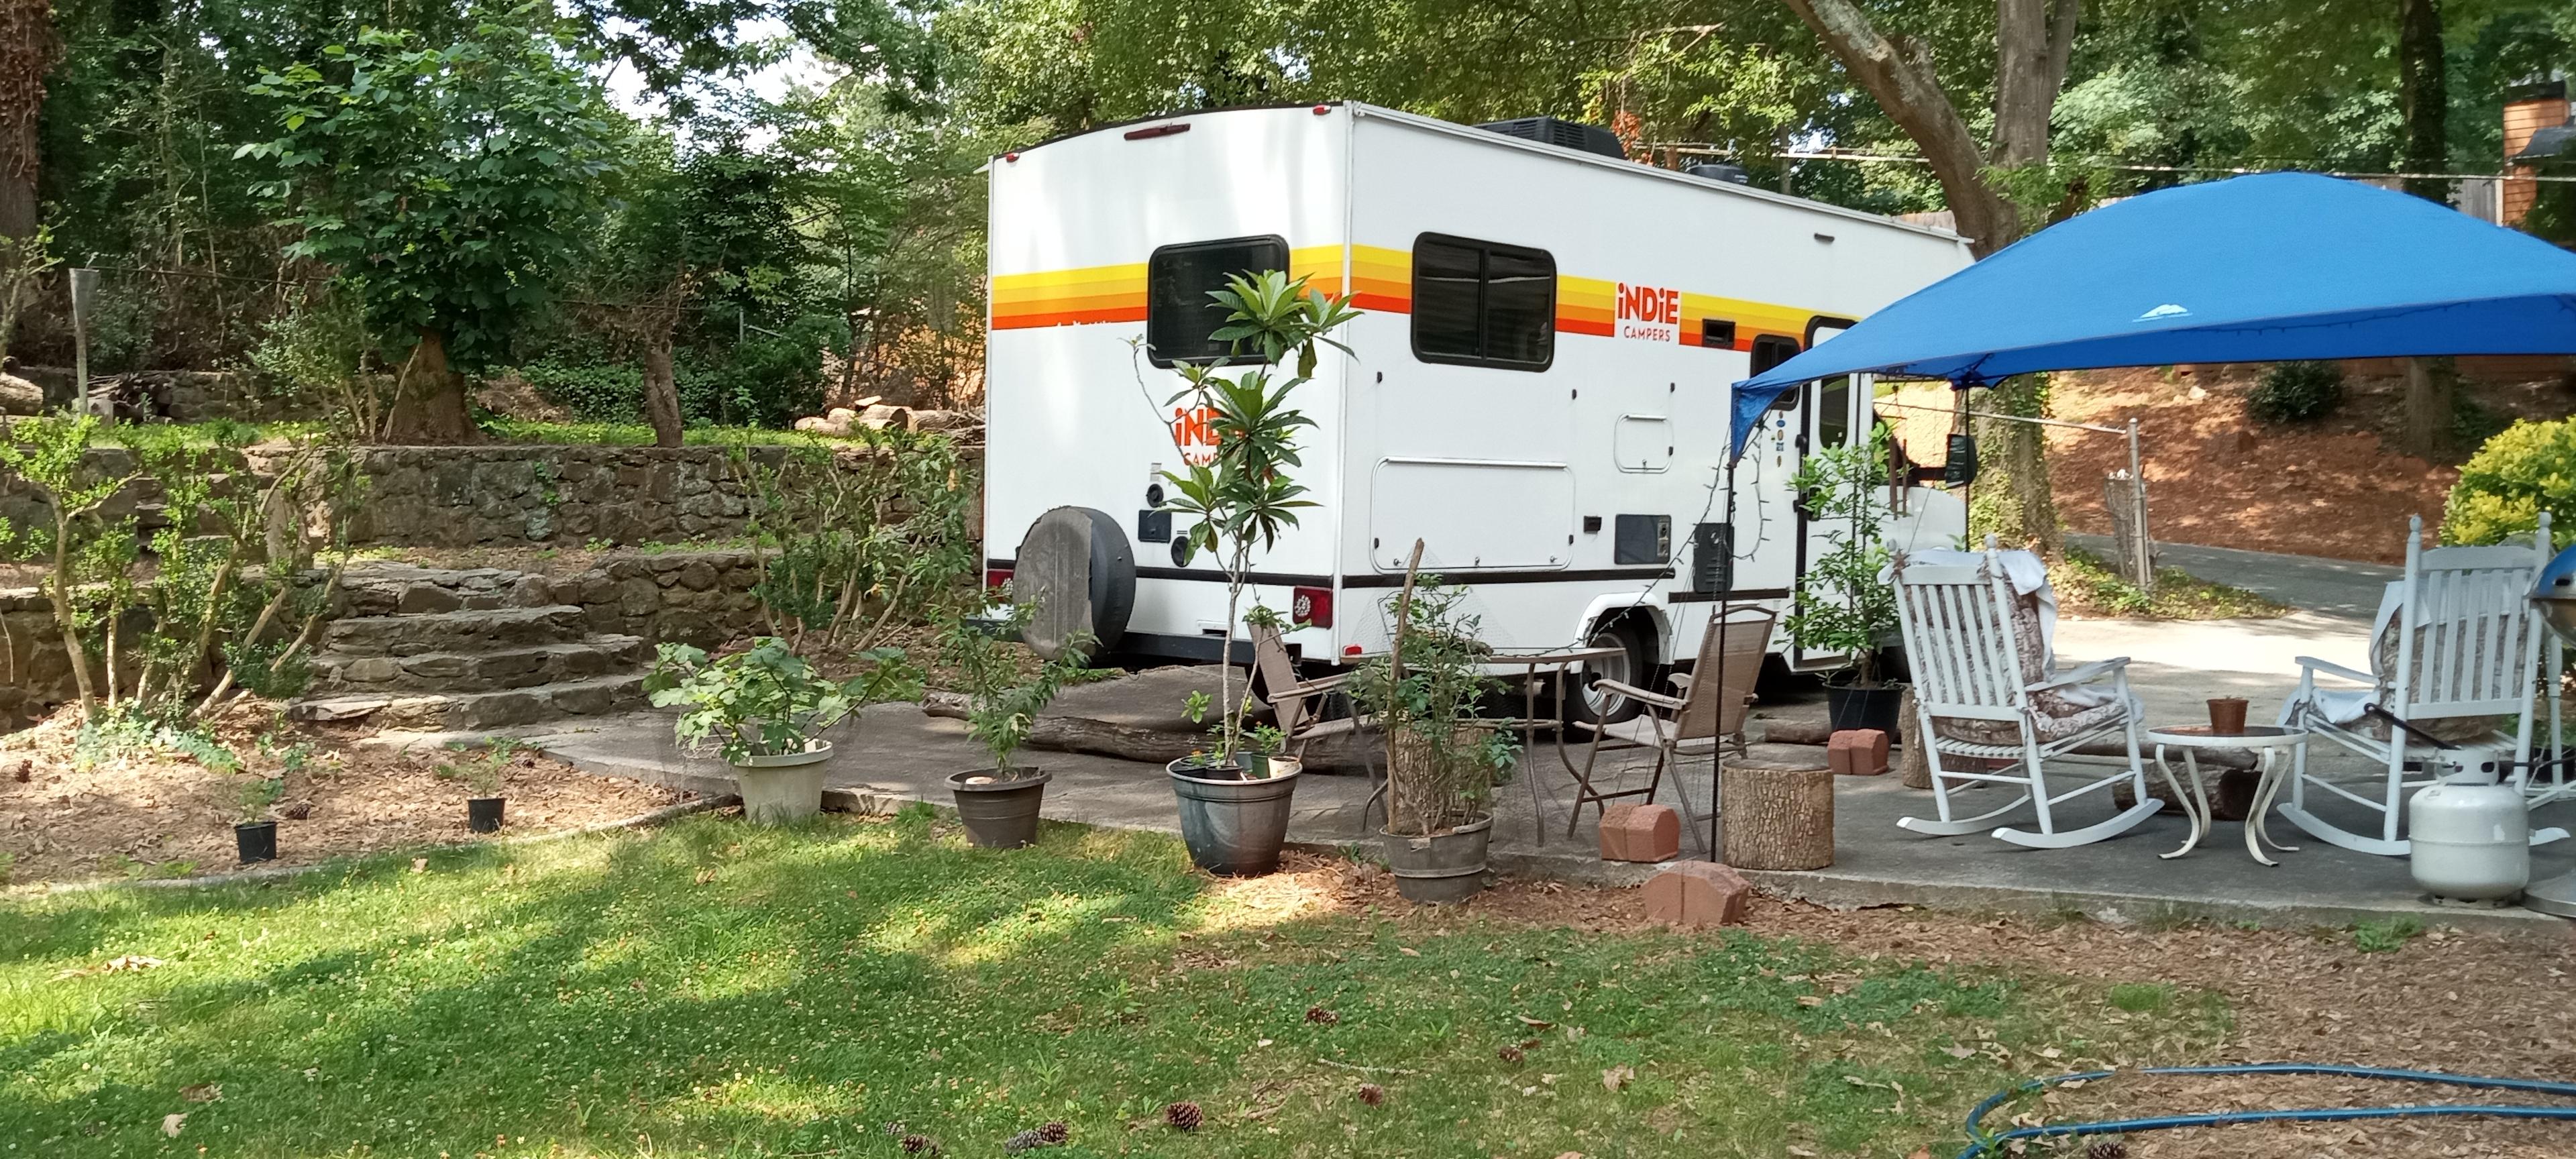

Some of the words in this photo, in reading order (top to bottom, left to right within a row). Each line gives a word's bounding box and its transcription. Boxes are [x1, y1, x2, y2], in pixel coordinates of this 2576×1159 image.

[1623, 325, 1670, 342] CAMPERS
[1175, 407, 1225, 447] iND
[1183, 452, 1220, 466] CAMP
